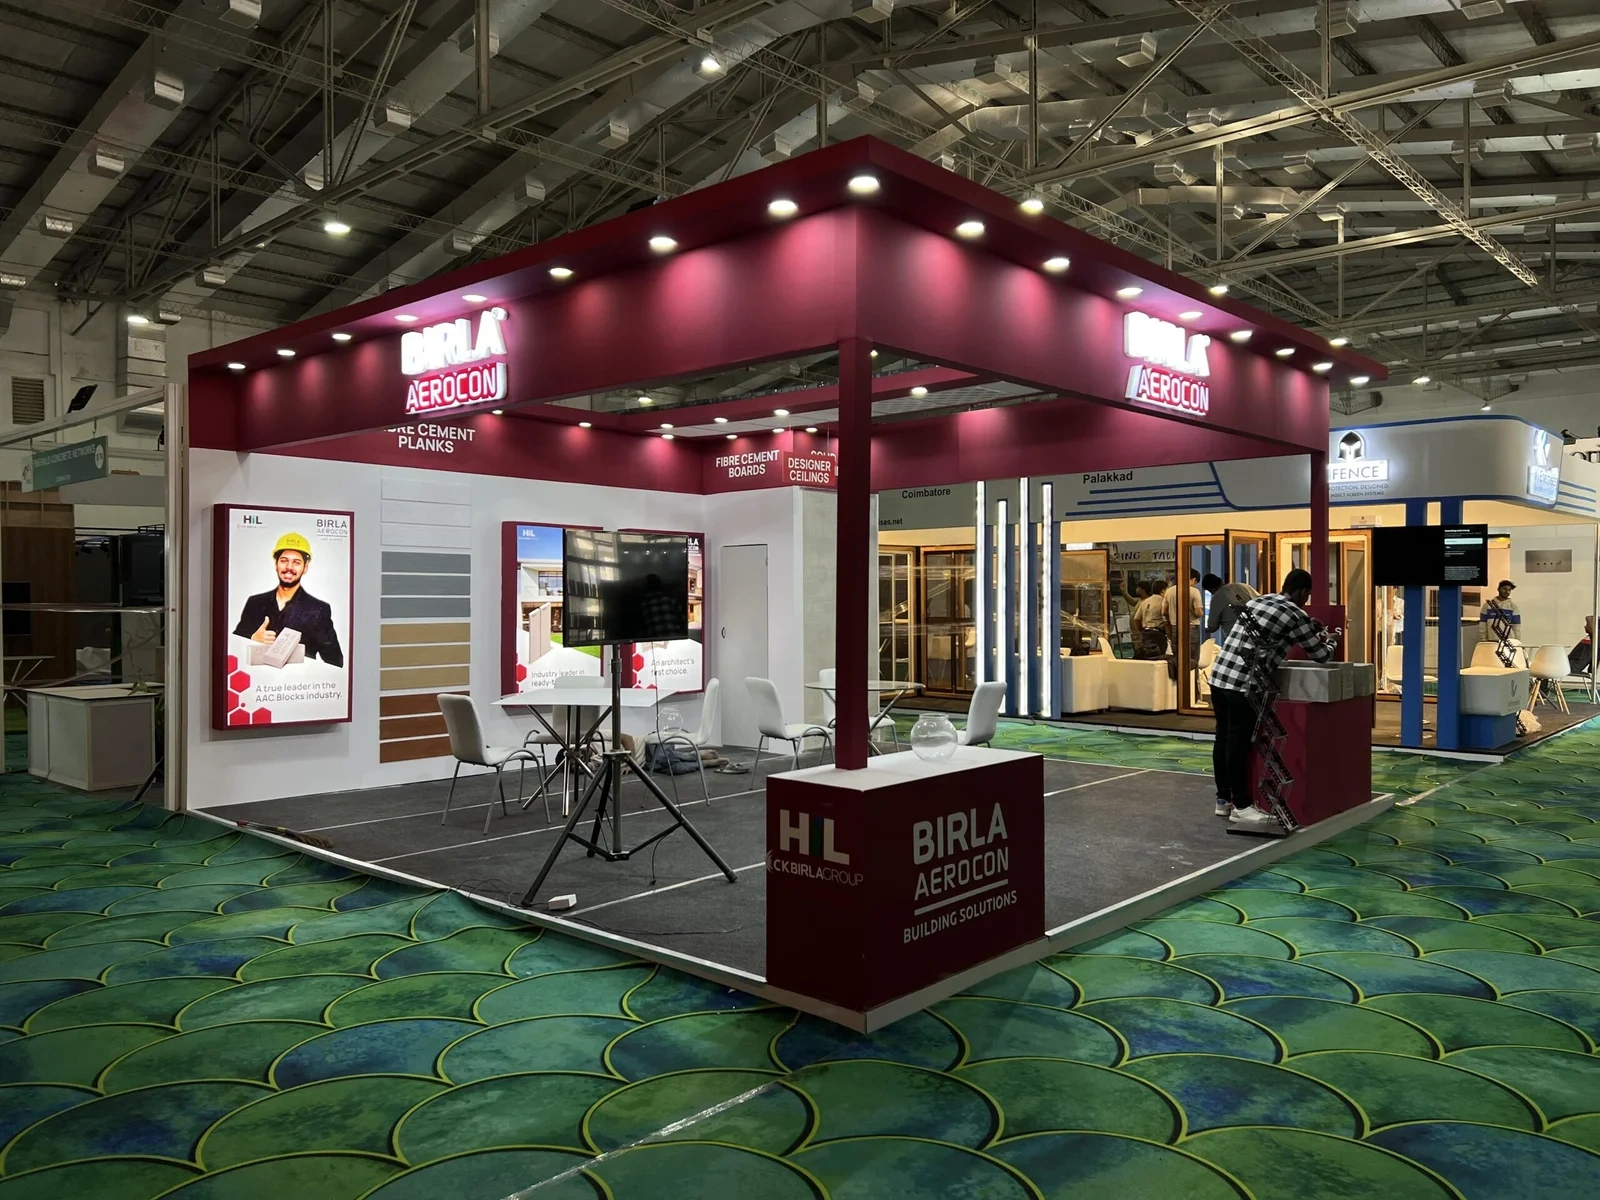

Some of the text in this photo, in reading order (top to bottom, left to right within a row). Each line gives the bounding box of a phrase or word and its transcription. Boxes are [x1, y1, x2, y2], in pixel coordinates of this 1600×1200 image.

[405, 367, 497, 411] AEROCON
[1138, 369, 1209, 412] AEROCON
[417, 423, 476, 441] CEMENT
[398, 435, 454, 453] PLANKS
[715, 449, 780, 468] FIBRE CEMENT
[788, 457, 831, 472] DESIGNER
[728, 464, 766, 478] BOARDS
[789, 469, 830, 484] CEILINGS
[1082, 471, 1133, 484] Palakkad
[1329, 466, 1379, 480] FENCE
[901, 487, 951, 499] Coimbatore
[1329, 484, 1359, 492] OTECTION.
[317, 519, 347, 529] BIRLA
[661, 658, 695, 666] architect's
[651, 668, 688, 676] frst choice.
[255, 681, 336, 693] A true leader in the
[255, 691, 343, 703] AAC Blocks industry.
[912, 802, 1008, 865] BIRLA
[914, 846, 1009, 901] AEROCON
[903, 890, 1018, 944] BUILDING SOLUTIONS
